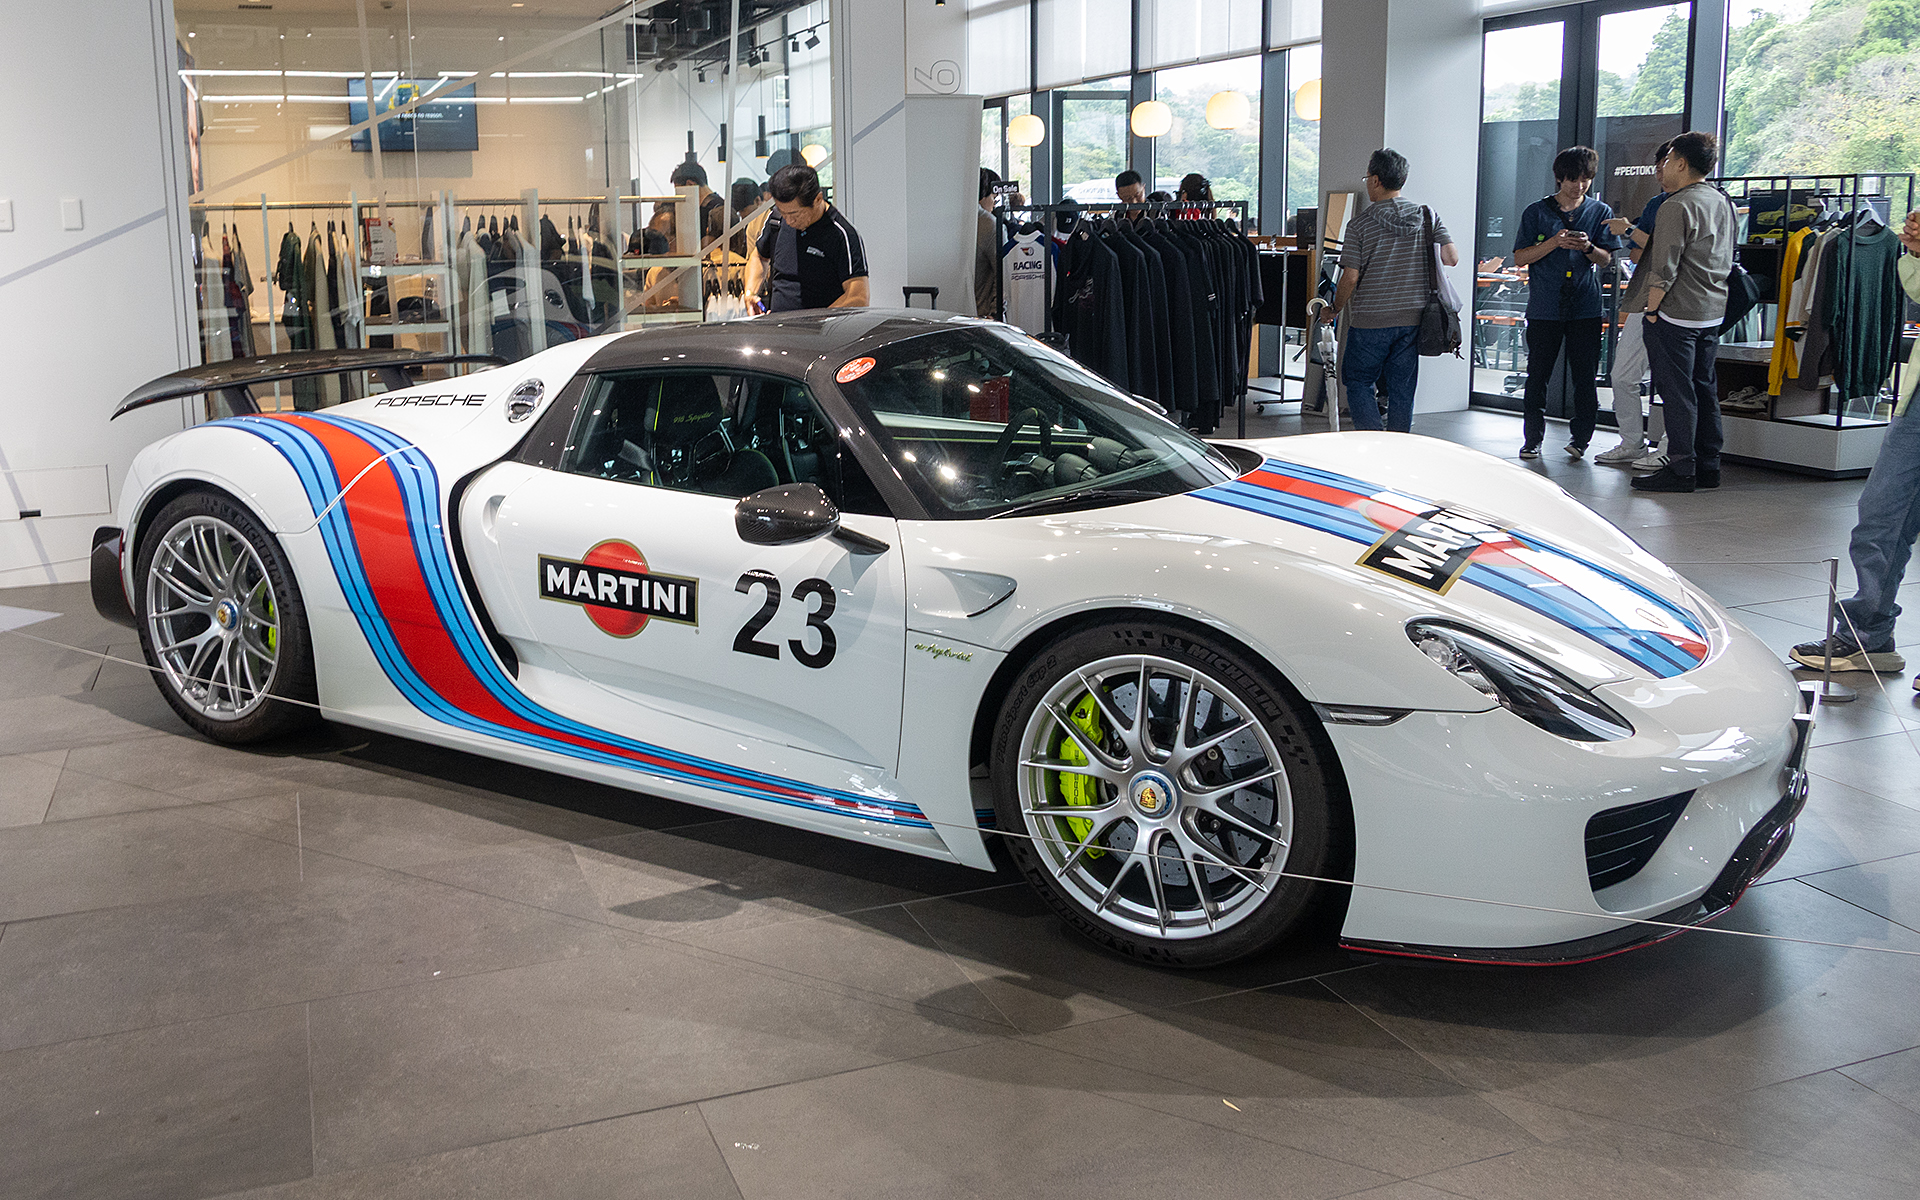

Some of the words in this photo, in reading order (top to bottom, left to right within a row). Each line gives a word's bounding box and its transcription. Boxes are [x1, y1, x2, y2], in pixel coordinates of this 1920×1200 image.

[992, 185, 1002, 194] On
[1003, 184, 1018, 193] Sale
[1013, 261, 1042, 271] RACING
[374, 394, 487, 408] PORSCHE
[546, 564, 697, 615] MARTINI
[733, 569, 837, 669] 23
[1006, 685, 1029, 726] Sport
[1027, 666, 1047, 688] Cup
[1046, 654, 1057, 669] 2
[1187, 643, 1282, 721] MICHELIN
